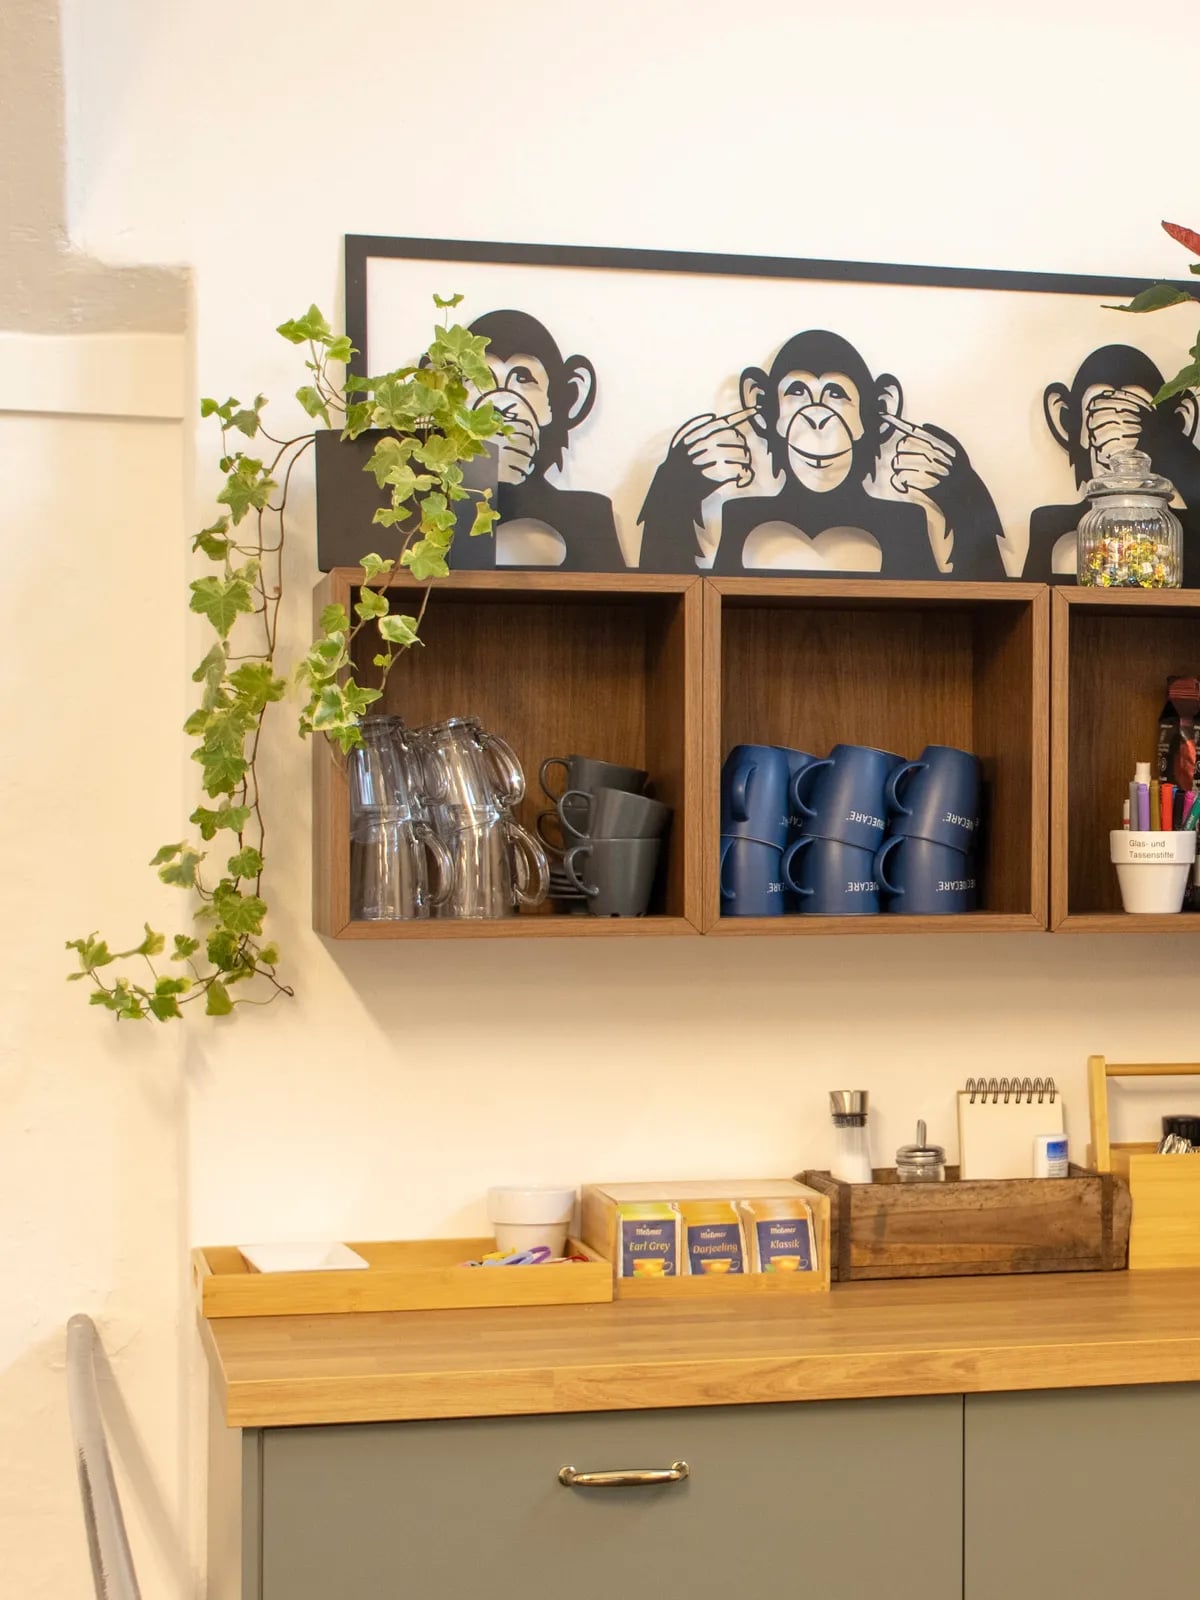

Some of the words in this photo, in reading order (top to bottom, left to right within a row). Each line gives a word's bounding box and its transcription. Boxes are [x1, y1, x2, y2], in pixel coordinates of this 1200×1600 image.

[1129, 840, 1148, 848] Glas-
[629, 1242, 647, 1252] Earl
[649, 1241, 671, 1253] Grey
[693, 1243, 738, 1254] Darjeeling
[770, 1240, 800, 1249] Klassik
